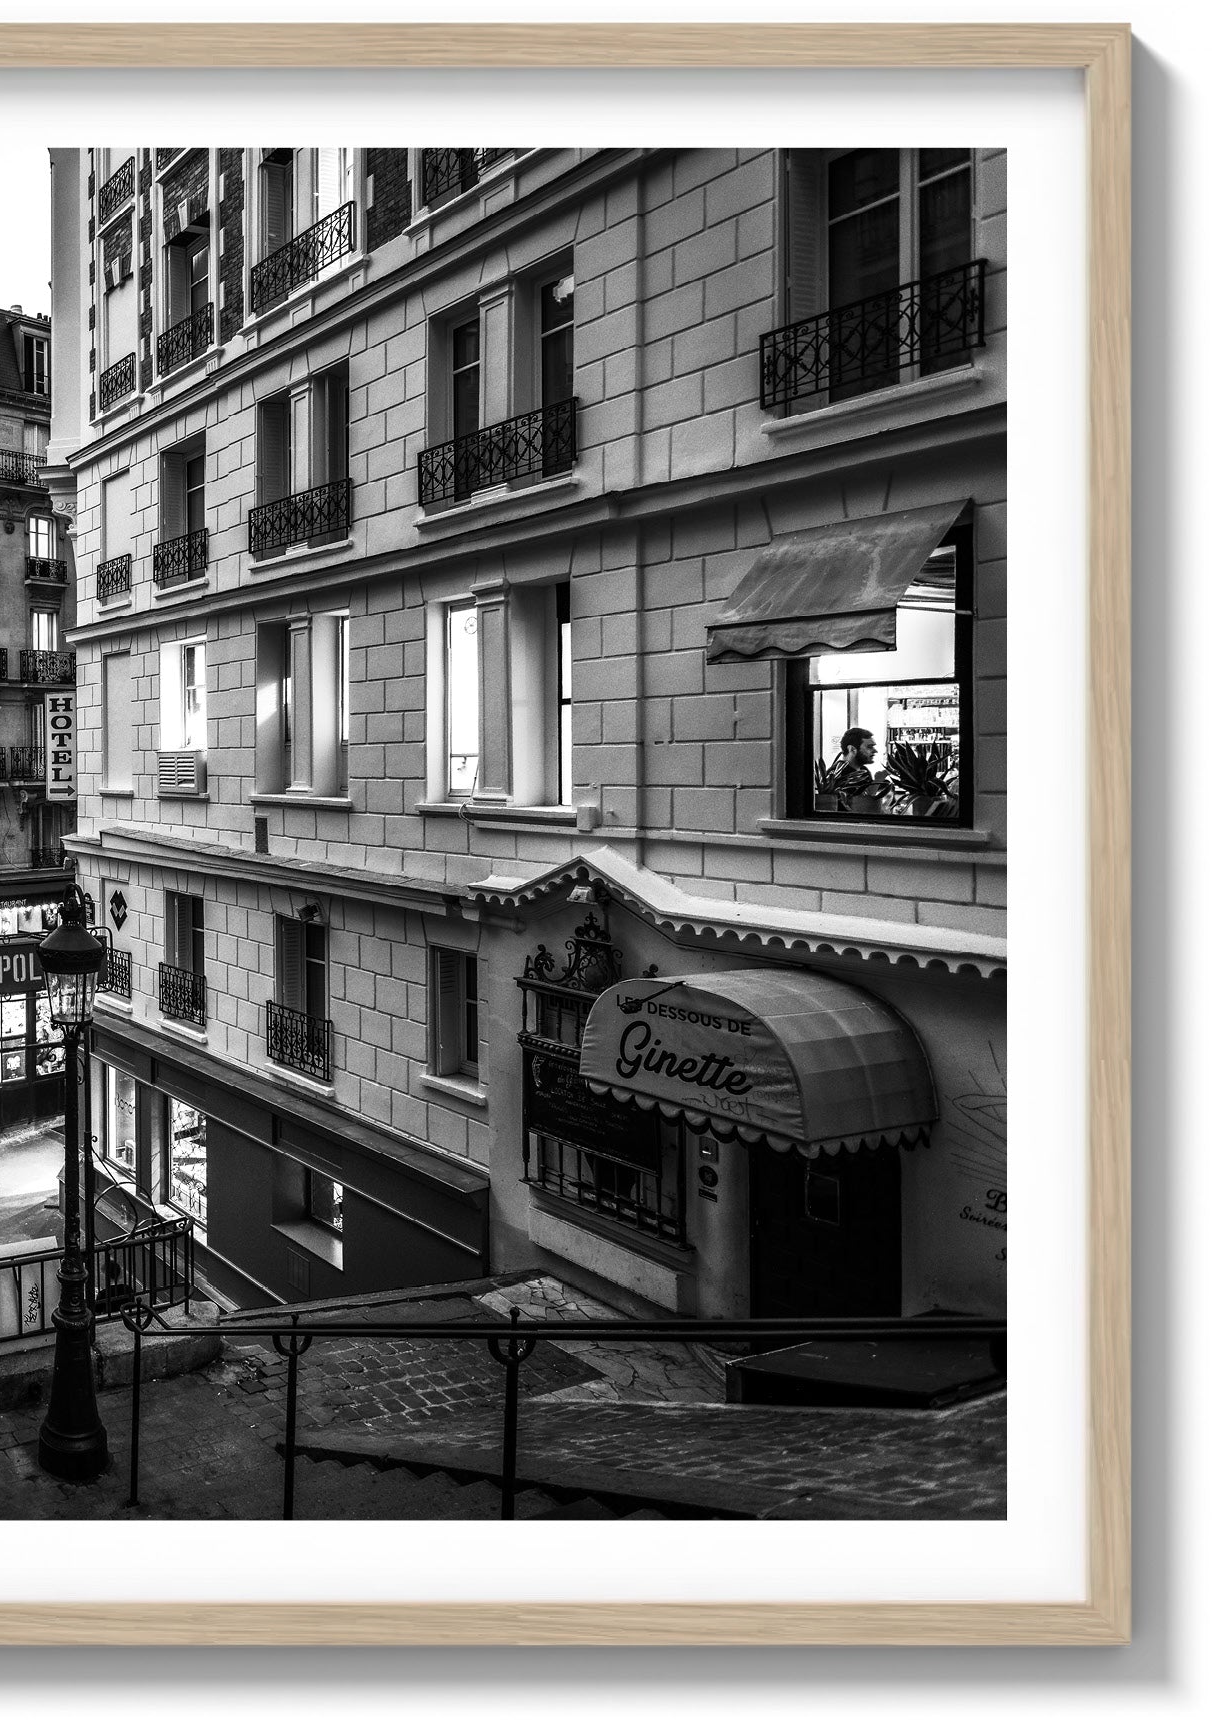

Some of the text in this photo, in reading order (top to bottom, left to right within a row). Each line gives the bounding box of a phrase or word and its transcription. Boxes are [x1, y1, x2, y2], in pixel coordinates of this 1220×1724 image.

[49, 697, 73, 782] HOTEL
[647, 1001, 722, 1030] DESSOUS
[727, 1018, 752, 1037] DE
[616, 1020, 753, 1095] Ginette
